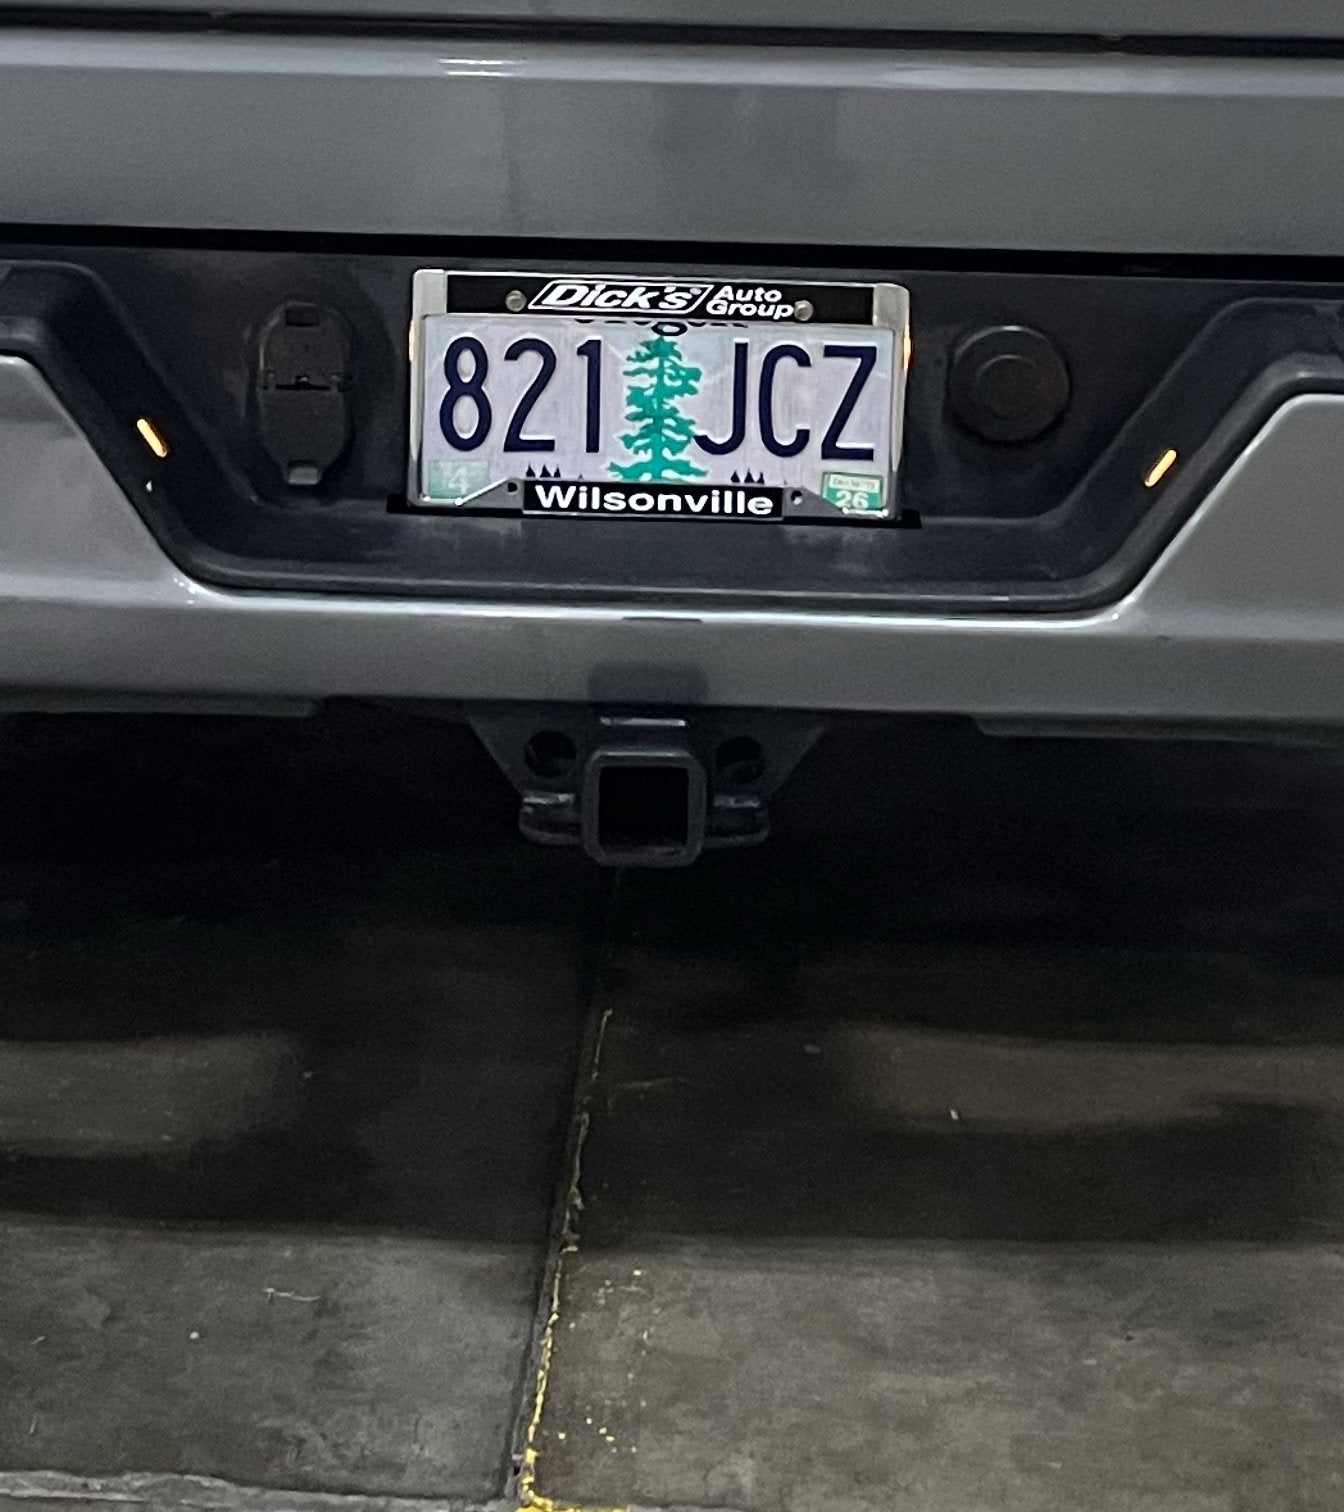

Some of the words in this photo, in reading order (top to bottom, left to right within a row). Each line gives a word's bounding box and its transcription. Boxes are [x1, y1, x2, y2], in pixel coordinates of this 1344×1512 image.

[540, 284, 692, 310] Dick's
[714, 286, 782, 303] Auto
[706, 300, 794, 319] Group
[438, 336, 602, 454] 821
[693, 341, 878, 462] JCZ
[535, 485, 774, 516] Wilsonville
[835, 490, 869, 509] 26
